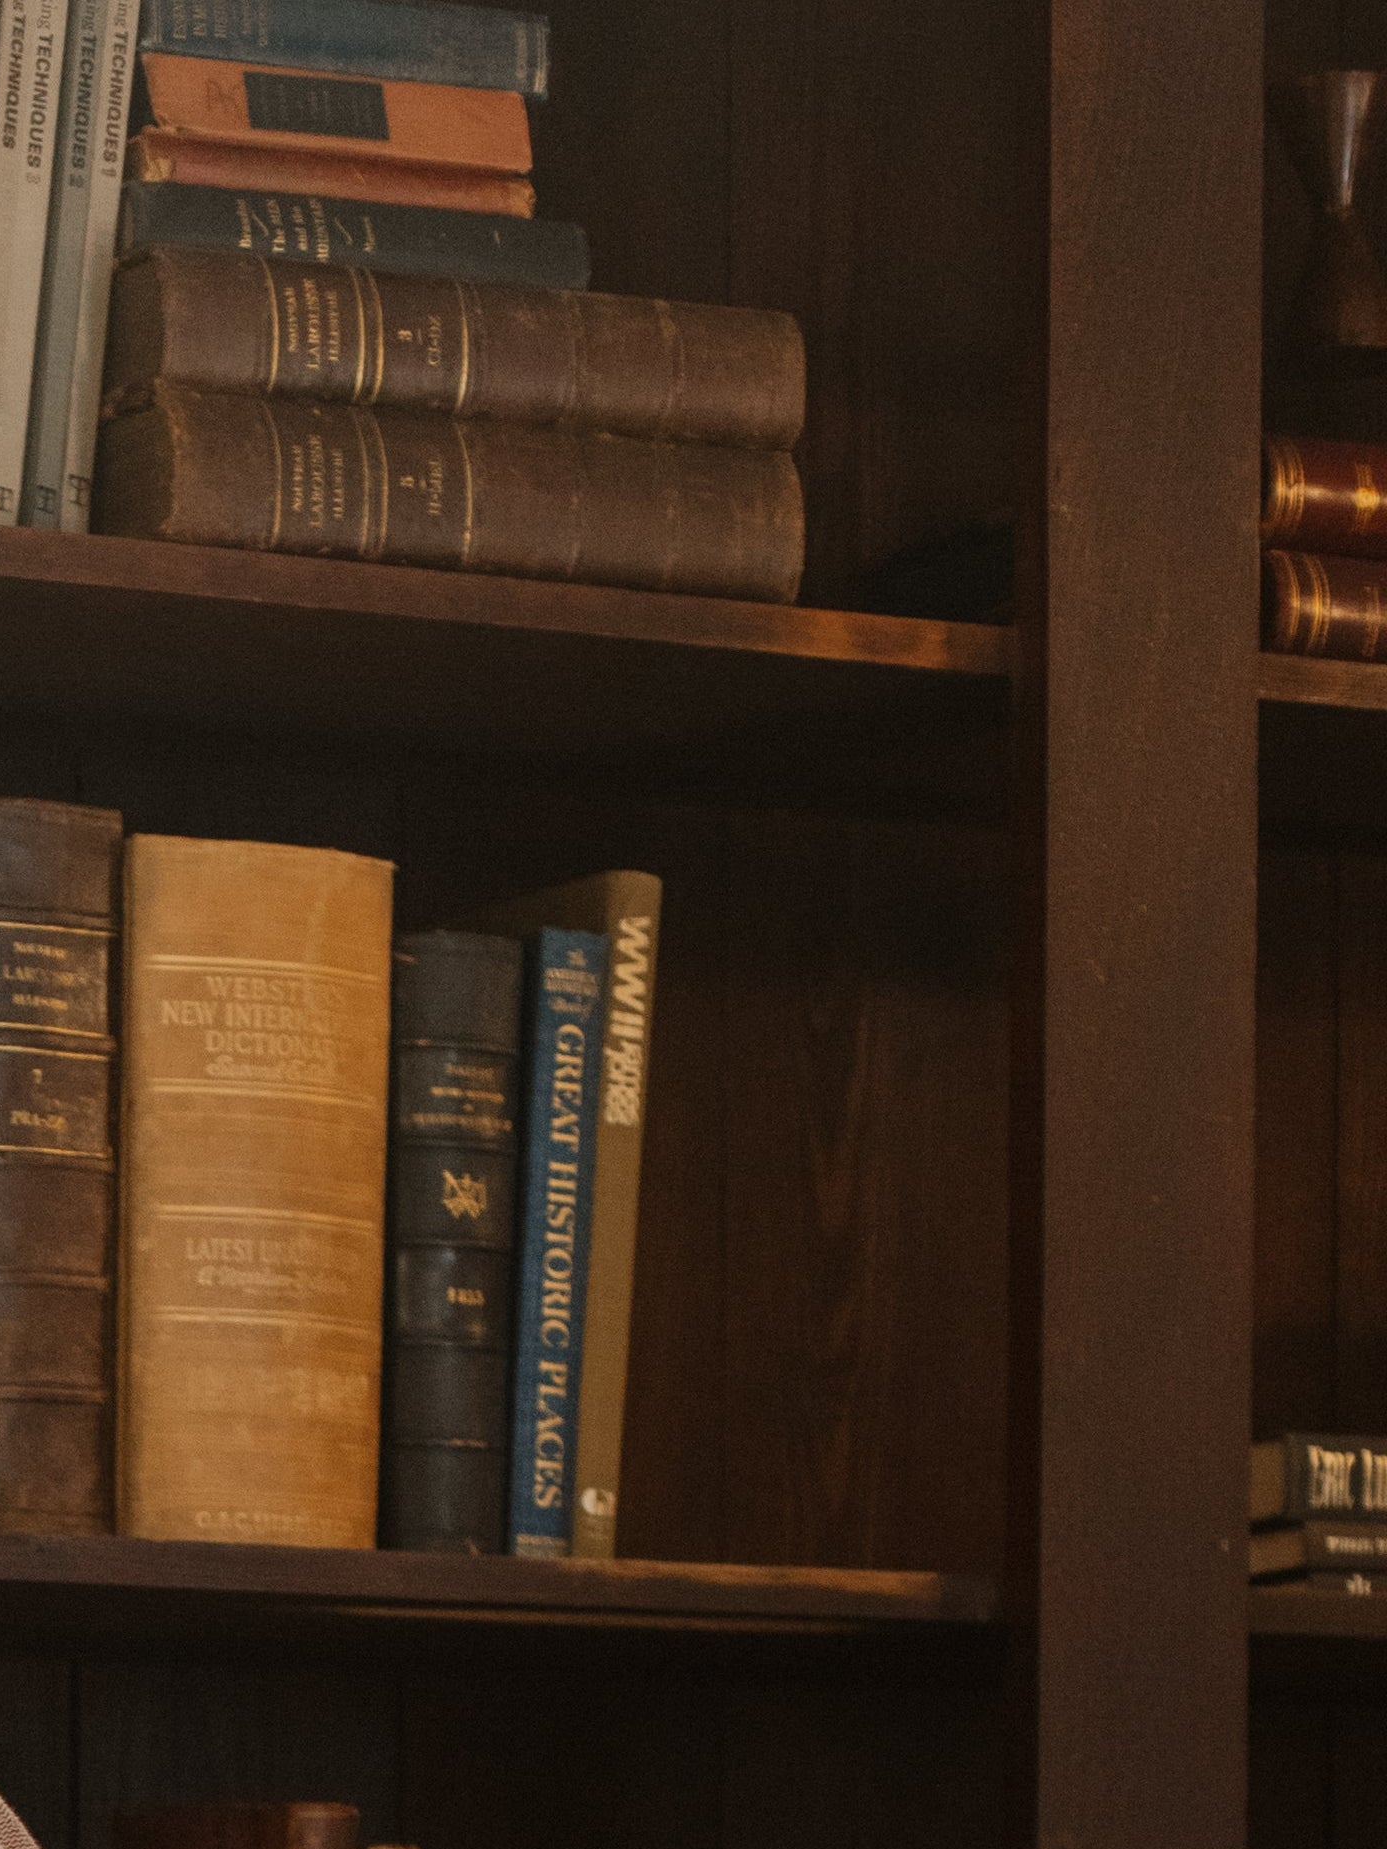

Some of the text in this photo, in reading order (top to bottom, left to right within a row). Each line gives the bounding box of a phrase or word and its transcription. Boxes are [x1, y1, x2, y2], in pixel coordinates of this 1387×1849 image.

[3, 15, 26, 149] TECHNIQUES
[27, 34, 54, 168] TECHNIQUES
[72, 35, 97, 169] TECHNIQUES
[103, 31, 128, 162] TECHNIQUES
[550, 1022, 586, 1154] GREAT
[539, 1159, 580, 1348] HISTORIC
[532, 1359, 569, 1508] PLACES
